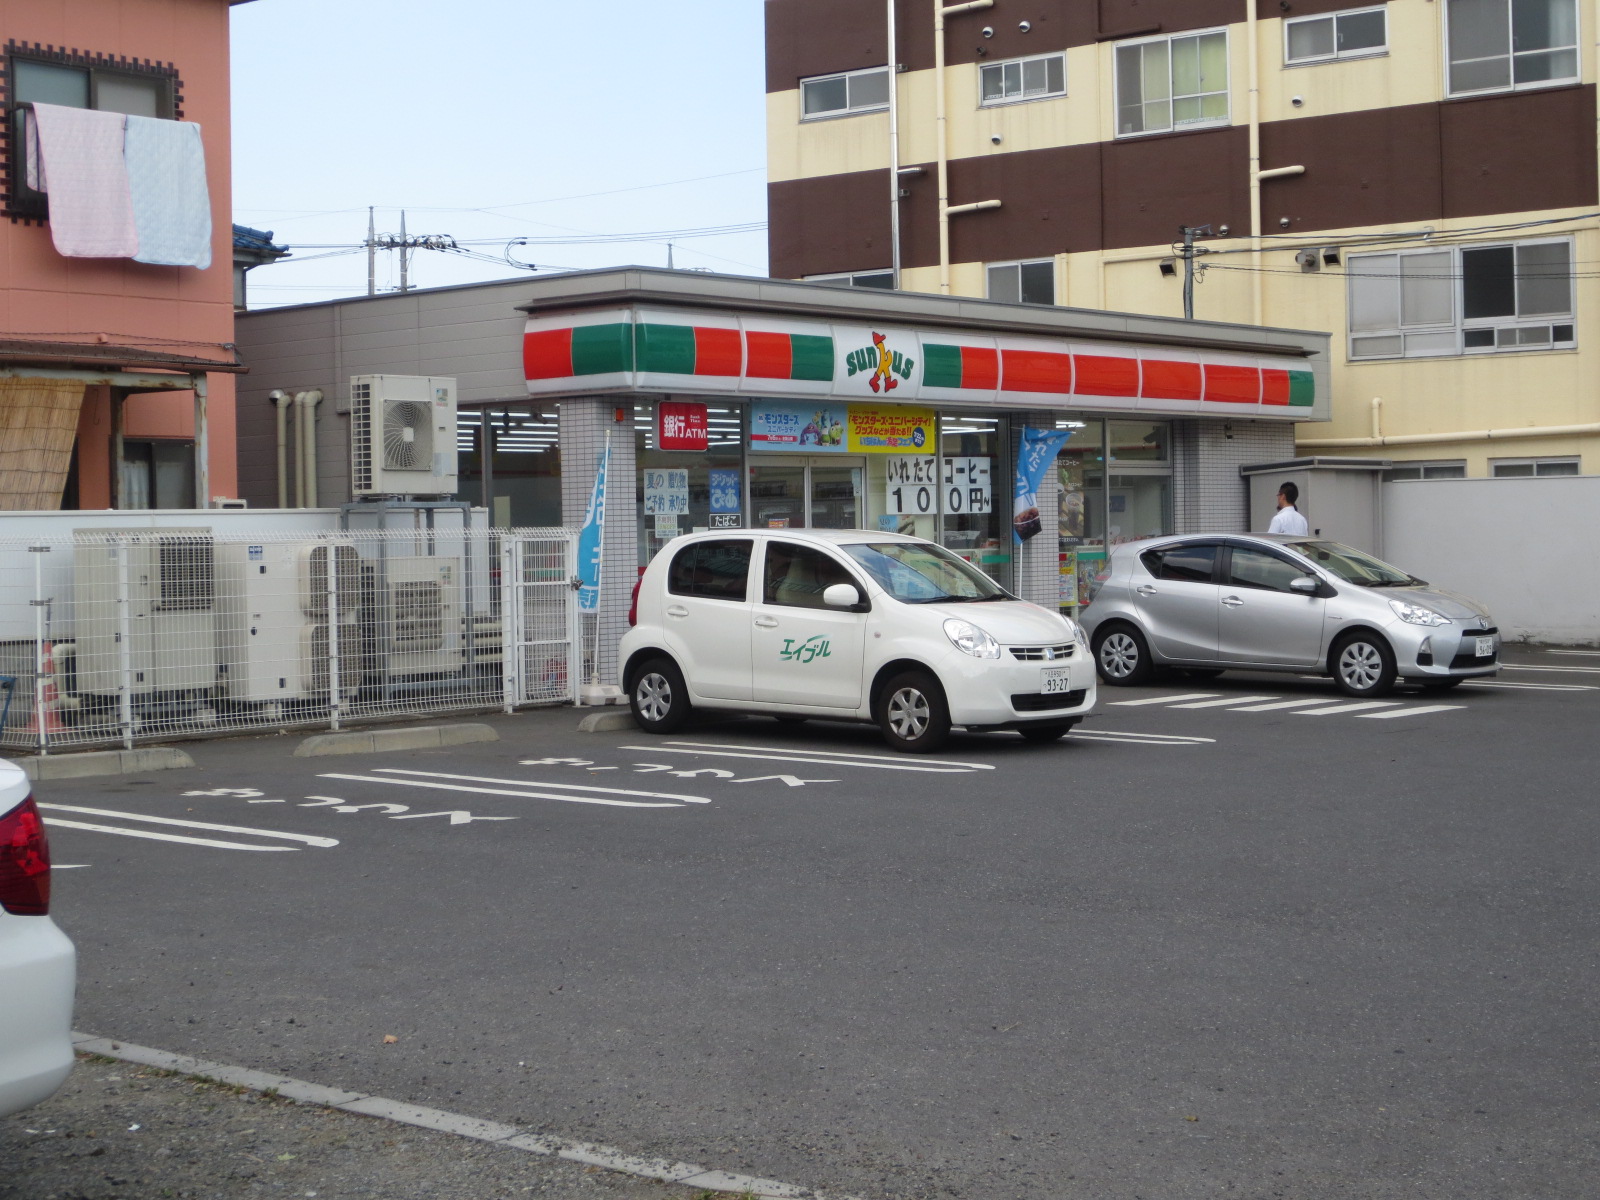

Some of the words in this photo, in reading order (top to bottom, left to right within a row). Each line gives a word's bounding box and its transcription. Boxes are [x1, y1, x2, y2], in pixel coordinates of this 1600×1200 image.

[664, 414, 686, 438] 銀行
[685, 428, 707, 439] ATM
[711, 473, 738, 487] チケット
[711, 488, 738, 509] ぴあ
[714, 515, 737, 527] たばこ
[779, 637, 832, 664] エイブル
